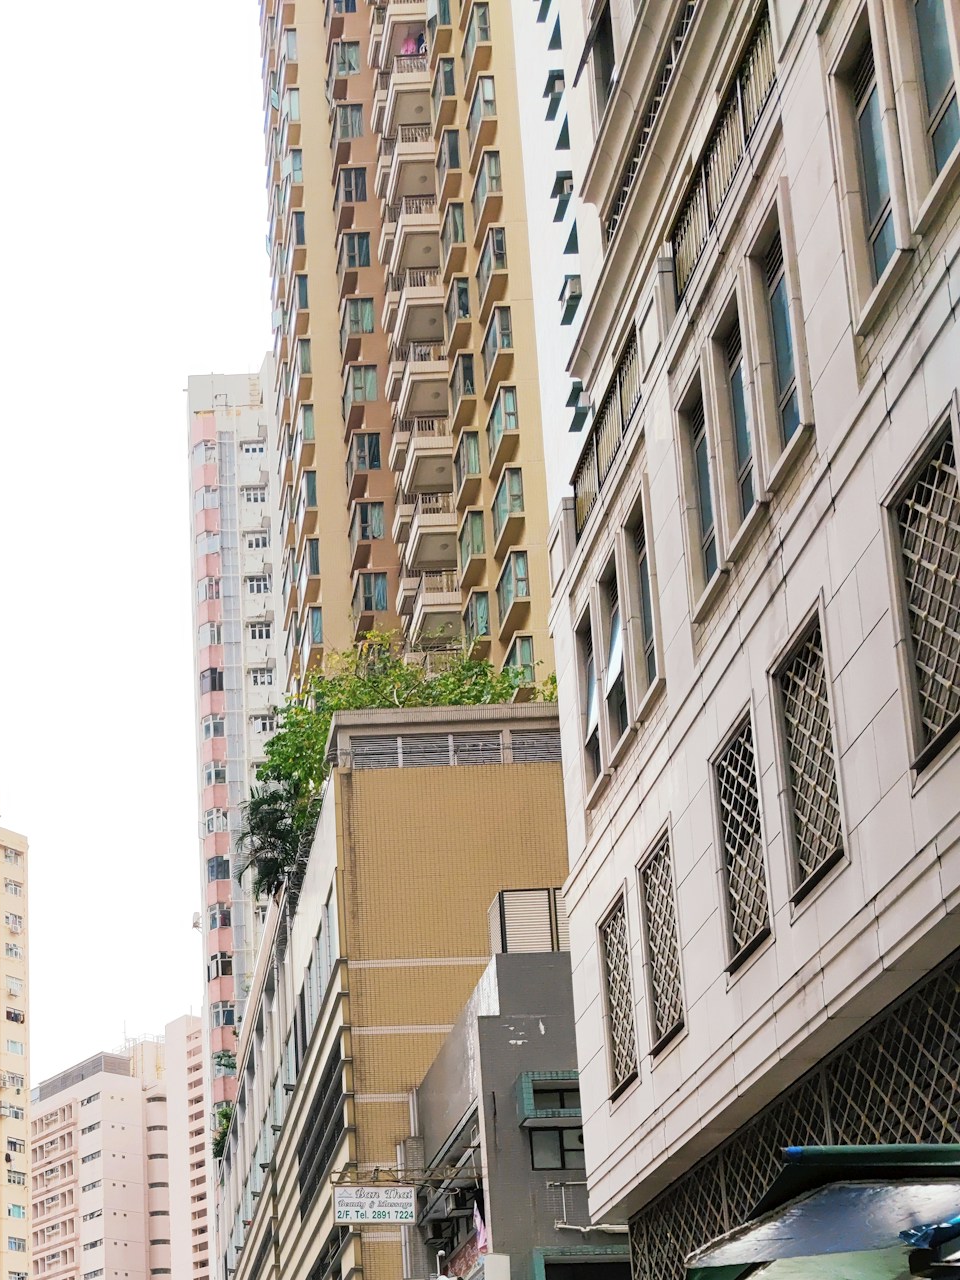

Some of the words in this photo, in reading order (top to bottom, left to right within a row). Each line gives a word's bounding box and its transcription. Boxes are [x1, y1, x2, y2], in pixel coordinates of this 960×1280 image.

[355, 1188, 380, 1199] Ban
[384, 1188, 413, 1199] Thai
[338, 1200, 366, 1209] Beauty
[377, 1200, 412, 1209] Massage
[355, 1211, 369, 1219] Tel.
[372, 1211, 391, 1219] 2891
[395, 1211, 414, 1219] 7224
